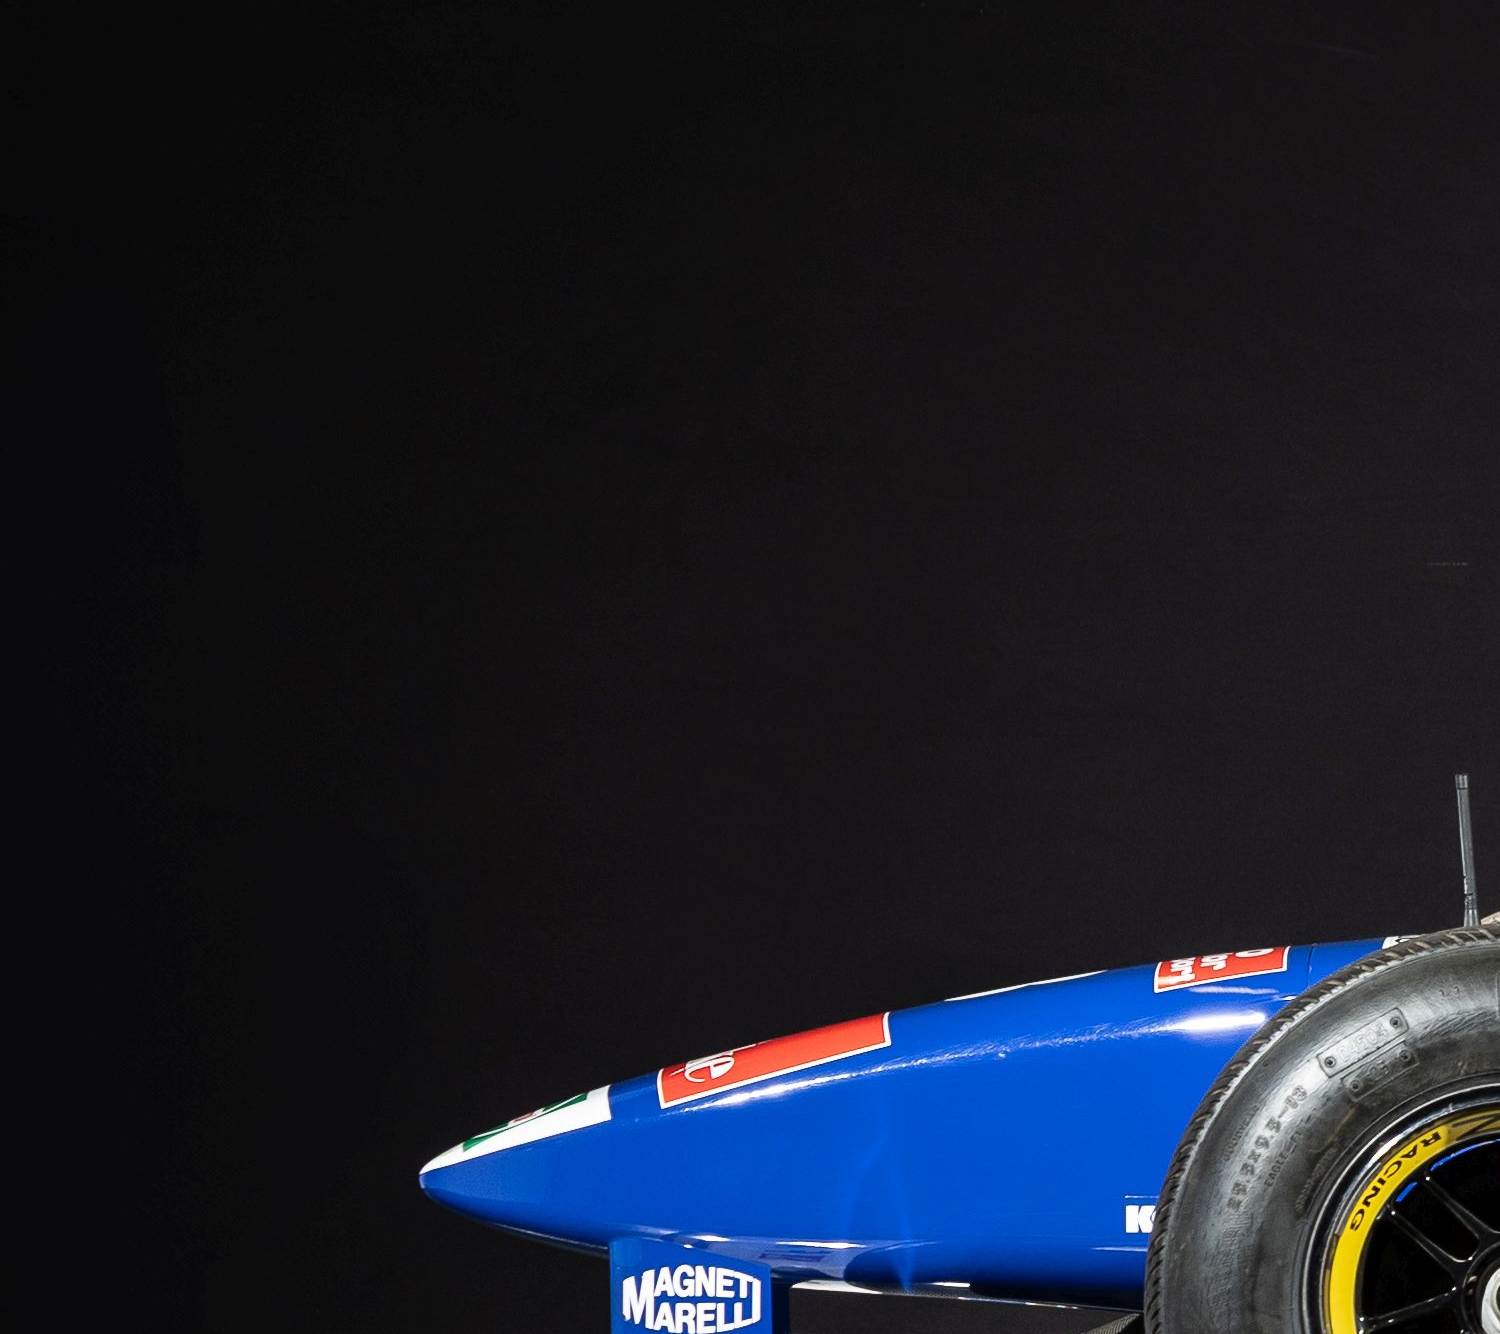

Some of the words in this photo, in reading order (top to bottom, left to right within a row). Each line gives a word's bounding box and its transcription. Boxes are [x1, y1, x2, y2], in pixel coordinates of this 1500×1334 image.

[1349, 1132, 1442, 1231] RACING
[623, 1264, 762, 1317] MAGNETI
[623, 1281, 762, 1334] MARELLI
